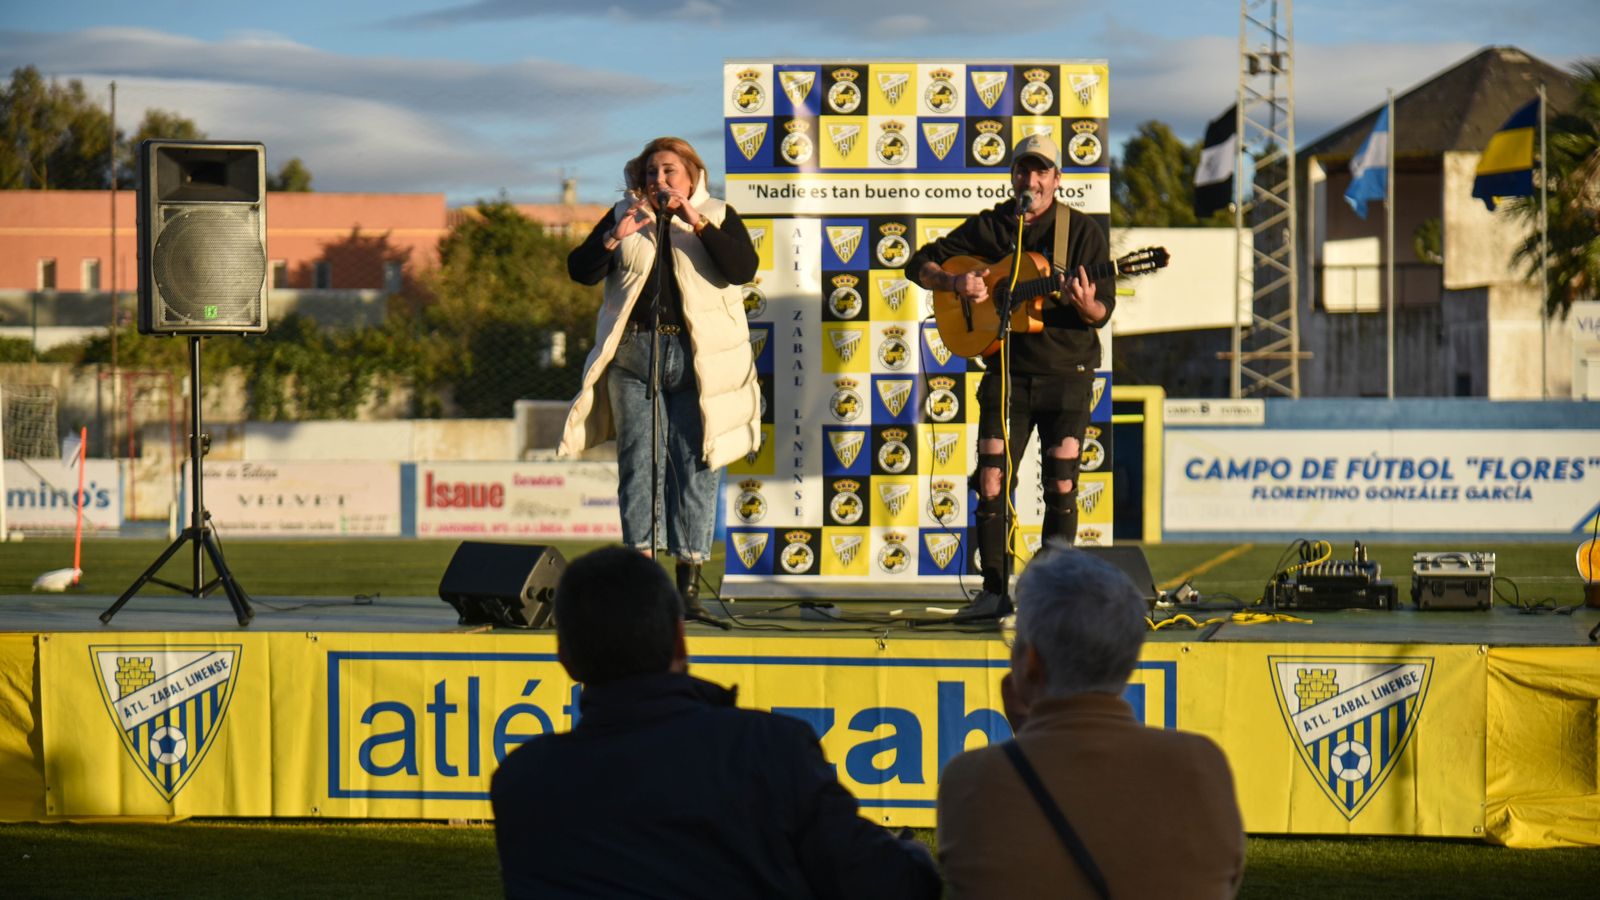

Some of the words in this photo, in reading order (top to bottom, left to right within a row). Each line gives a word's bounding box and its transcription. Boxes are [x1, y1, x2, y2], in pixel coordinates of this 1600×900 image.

[748, 184, 806, 199] "Nadie
[810, 188, 829, 199] es
[832, 186, 860, 199] tan
[865, 184, 920, 199] bueno
[924, 187, 973, 199] como
[977, 184, 1014, 199] todo
[792, 310, 804, 386] ZABAL
[793, 409, 804, 517] LINENSE
[1185, 456, 1291, 481] CAMPO
[1301, 456, 1338, 480] DE
[1347, 451, 1454, 481] FÚTBOL
[1465, 456, 1600, 481] "FLORES"
[425, 471, 505, 508] Isaue
[1252, 486, 1359, 501] FLORENTINO
[1365, 483, 1460, 501] GONZÁLEZ
[1466, 482, 1533, 501] GARCÍA
[124, 700, 149, 719] ATL.
[150, 682, 184, 706] ZABAL
[185, 657, 229, 687] LINENSE
[1303, 714, 1331, 733] ATL.
[1332, 694, 1370, 719] ZABAL
[1371, 670, 1419, 701] LINENSE
